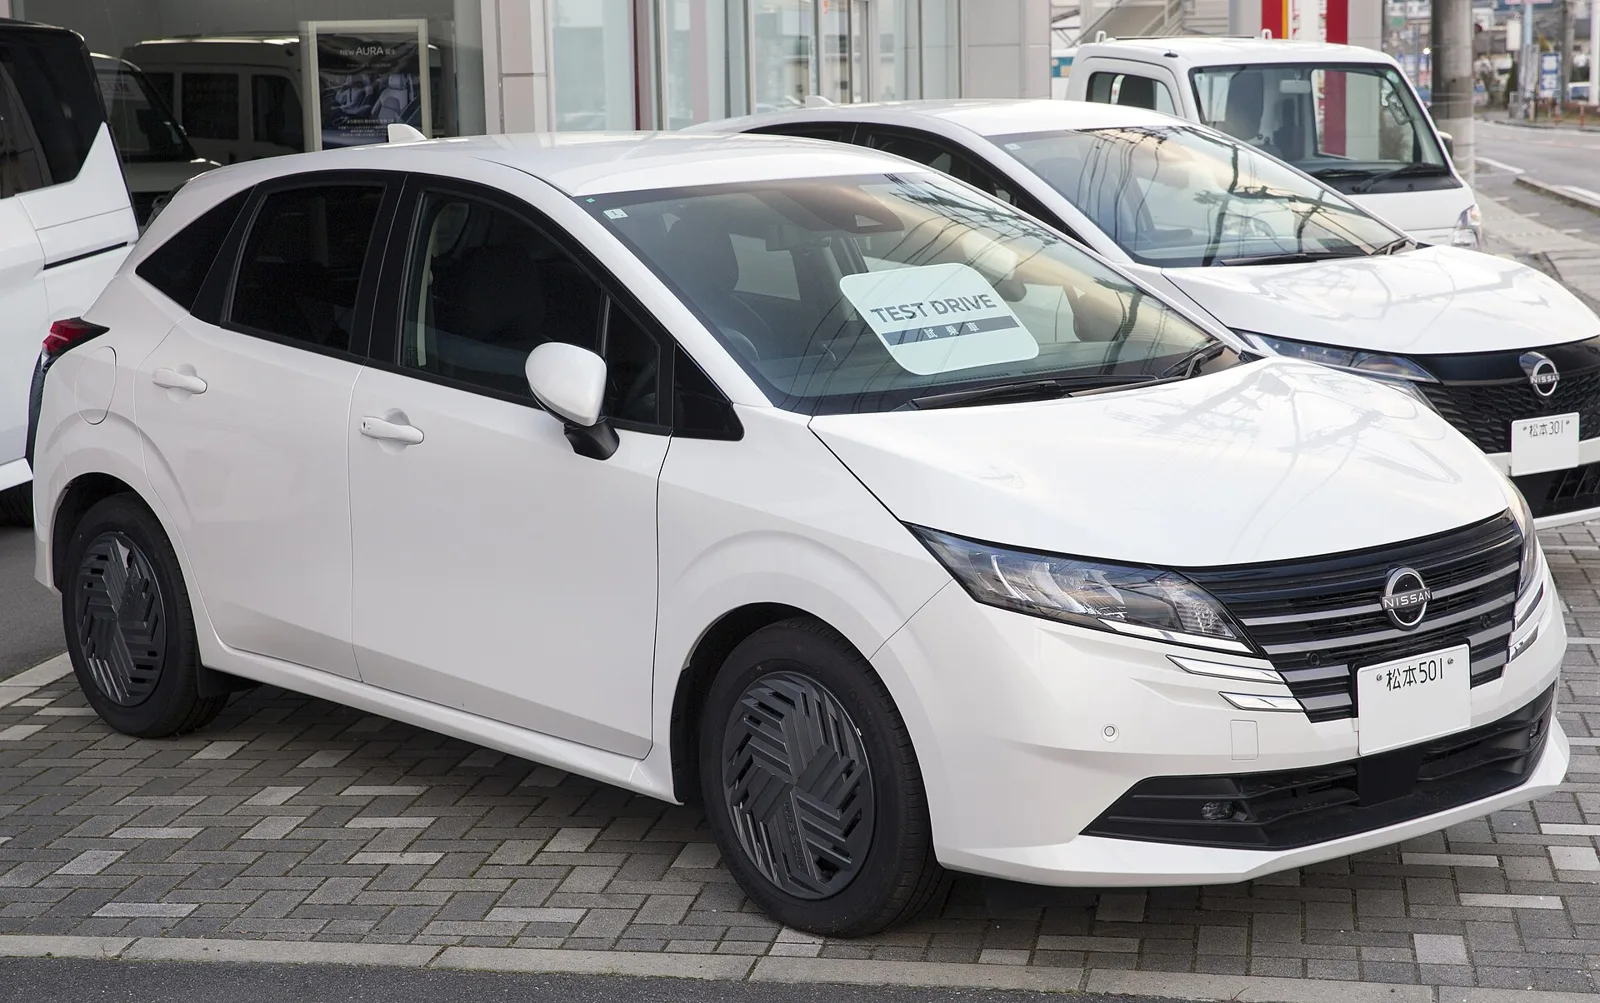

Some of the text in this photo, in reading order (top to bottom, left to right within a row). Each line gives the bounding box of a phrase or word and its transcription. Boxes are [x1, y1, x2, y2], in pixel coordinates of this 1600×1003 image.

[355, 46, 384, 56] AURA
[870, 294, 997, 323] TEST DRIVE
[1531, 373, 1560, 385] NISSAN
[1384, 590, 1431, 608] NISSAN
